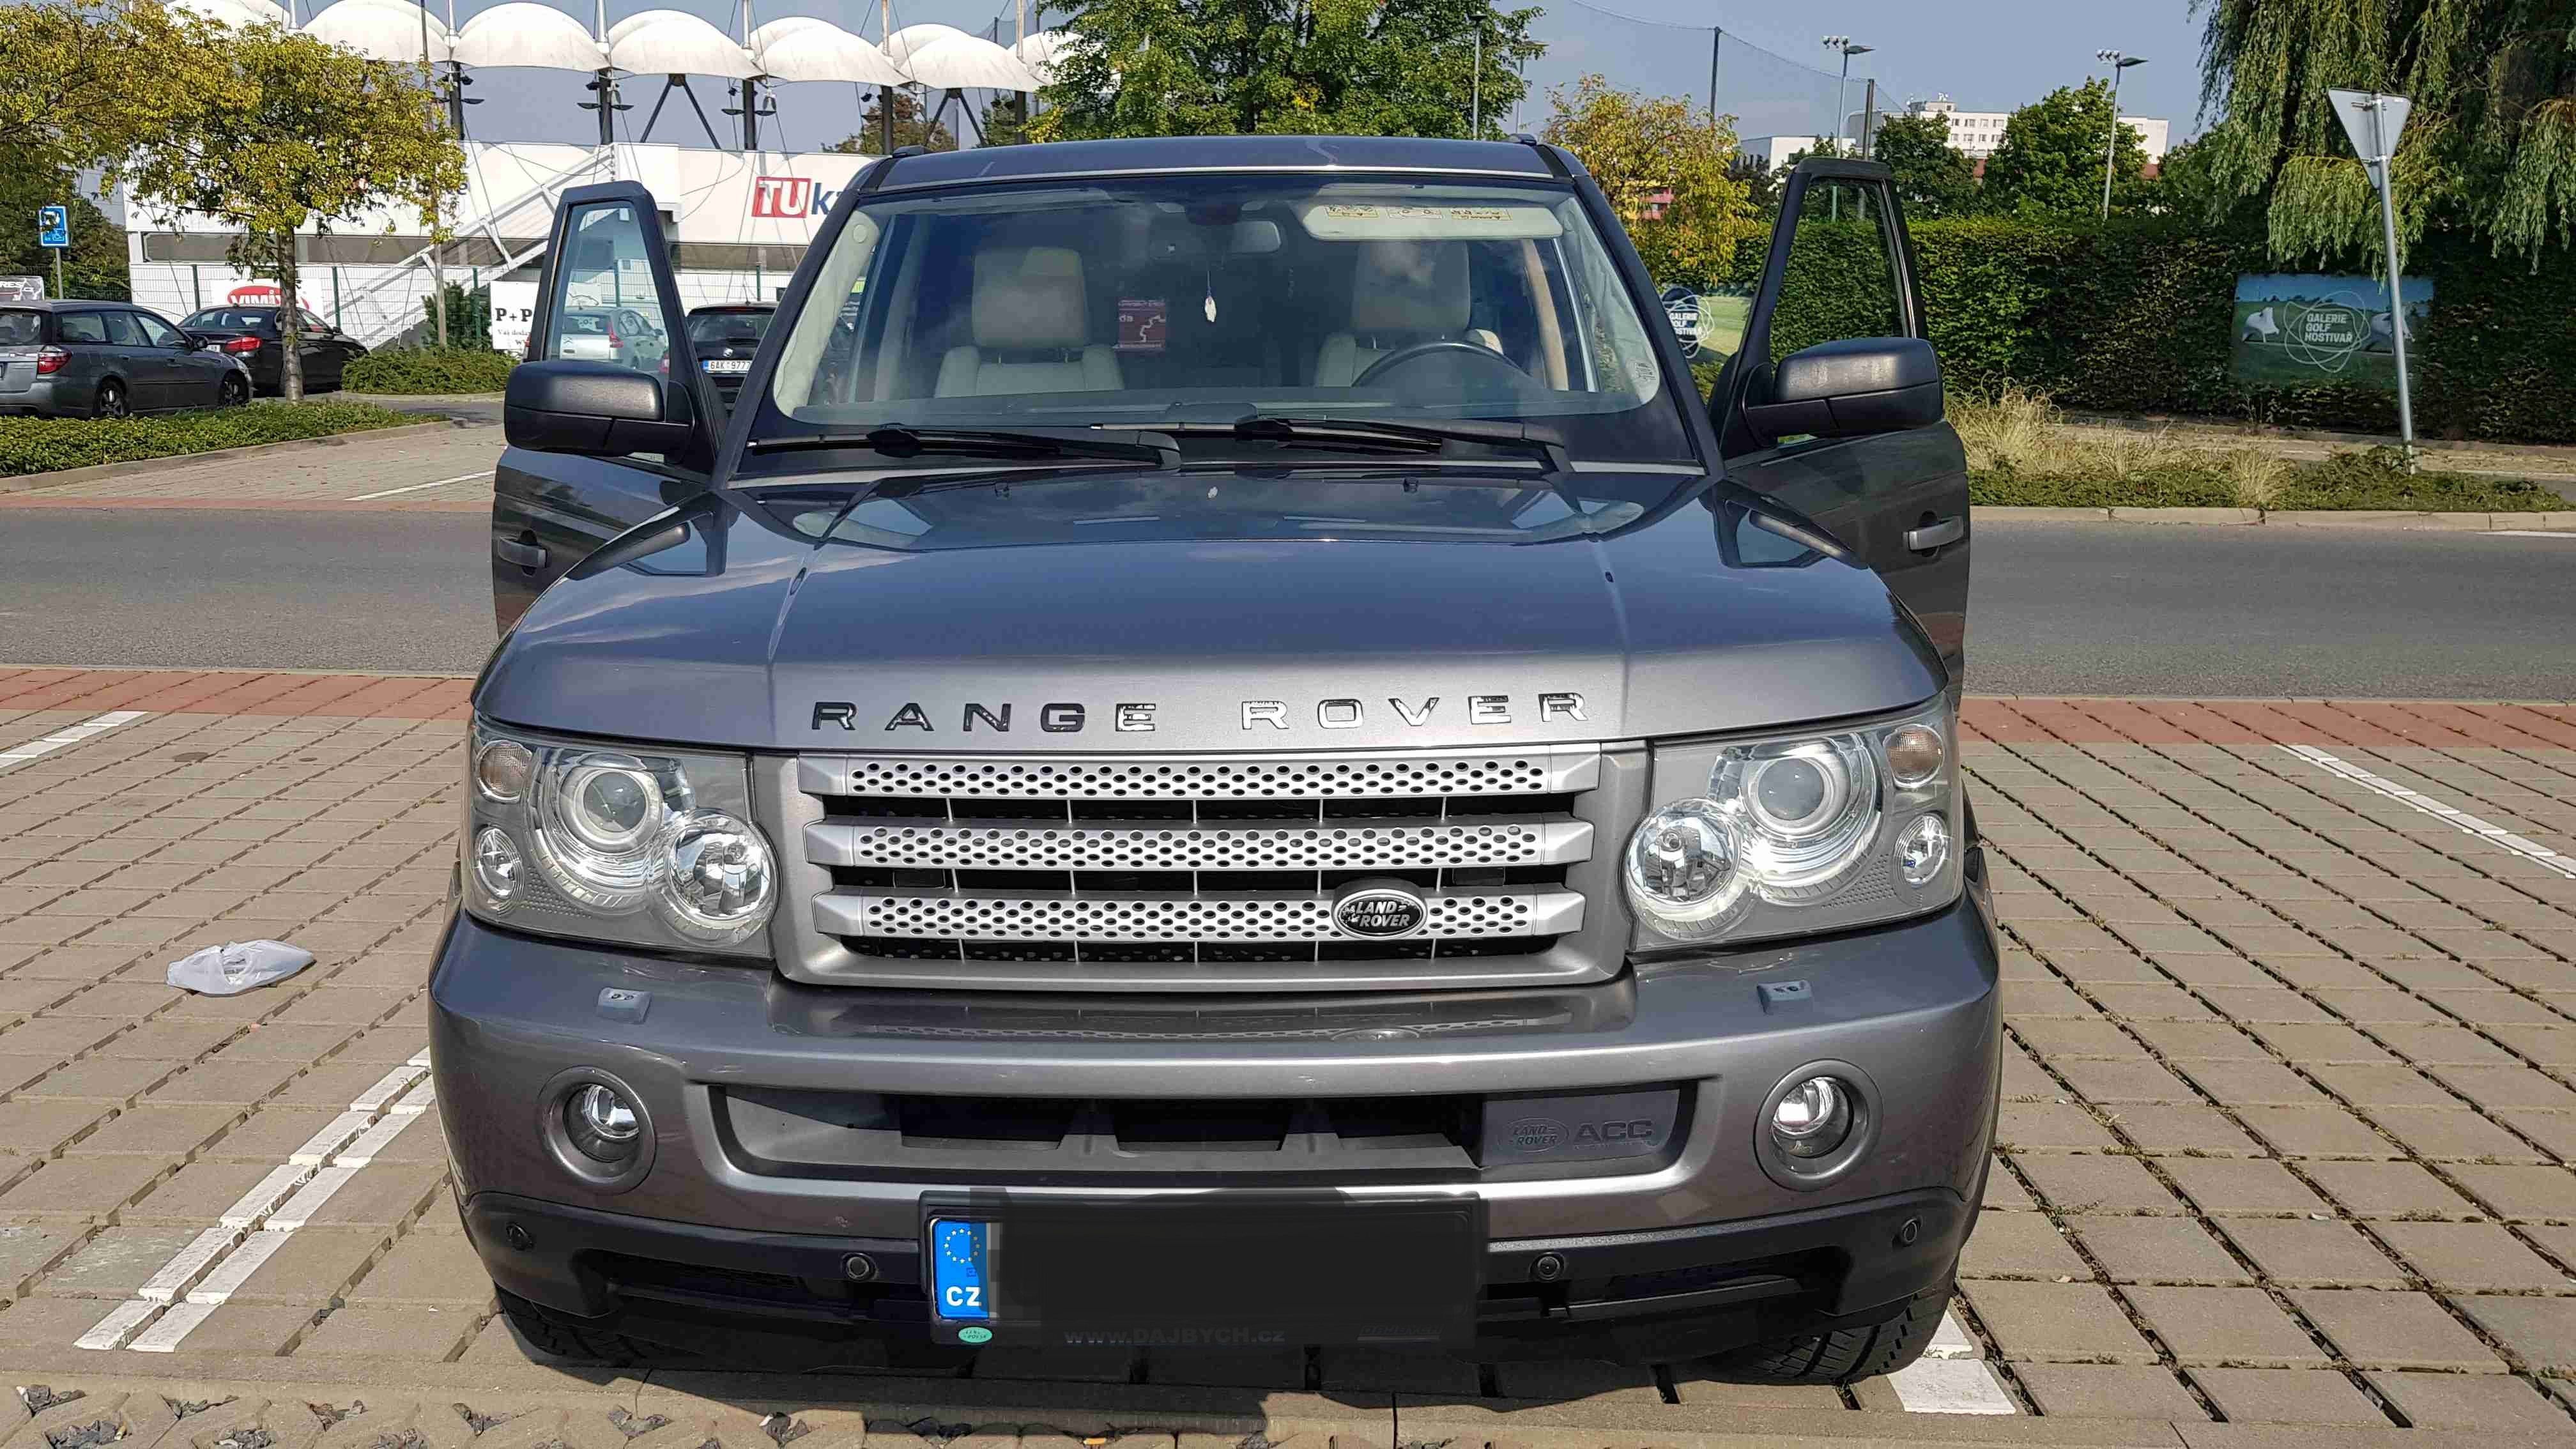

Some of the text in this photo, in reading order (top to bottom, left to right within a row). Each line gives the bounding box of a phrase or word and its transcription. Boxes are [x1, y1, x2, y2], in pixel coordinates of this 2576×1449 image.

[2307, 313, 2347, 324] GALERIE
[2306, 323, 2331, 332] GOLF
[2304, 331, 2353, 342] HOSTIVAŘ
[811, 692, 1589, 732] RANGE ROVER
[1356, 901, 1397, 914] LAND
[1360, 914, 1411, 926] ROVER
[1574, 1119, 1654, 1142] ACC
[1517, 1134, 1558, 1146] ROVER
[946, 1286, 982, 1307] CZ
